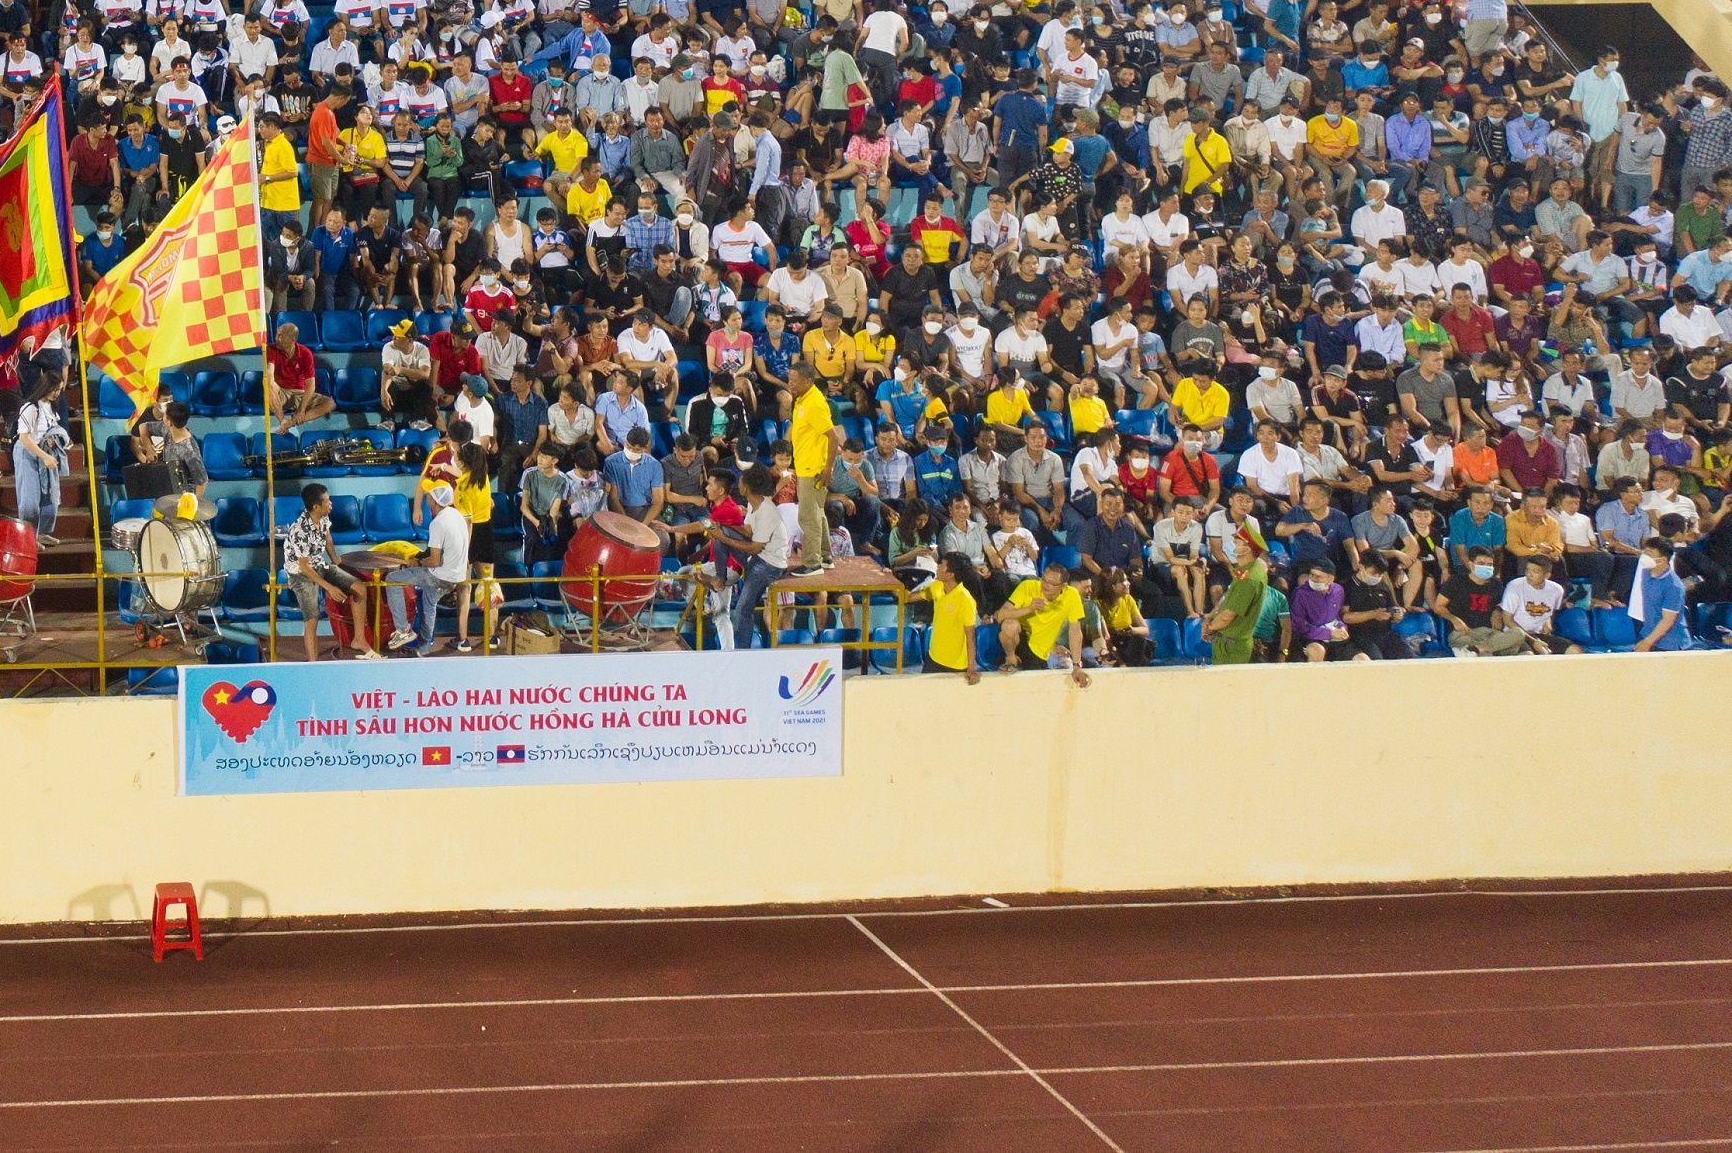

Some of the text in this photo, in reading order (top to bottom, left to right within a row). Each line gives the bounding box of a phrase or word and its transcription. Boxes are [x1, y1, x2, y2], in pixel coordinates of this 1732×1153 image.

[351, 682, 687, 712] VIỆT LÀO HAI NƯỚC CHÚNG TA
[296, 705, 747, 736] TÌNH SÂU HƠN NƯỚC HỒNG HÀ CỬU LONG
